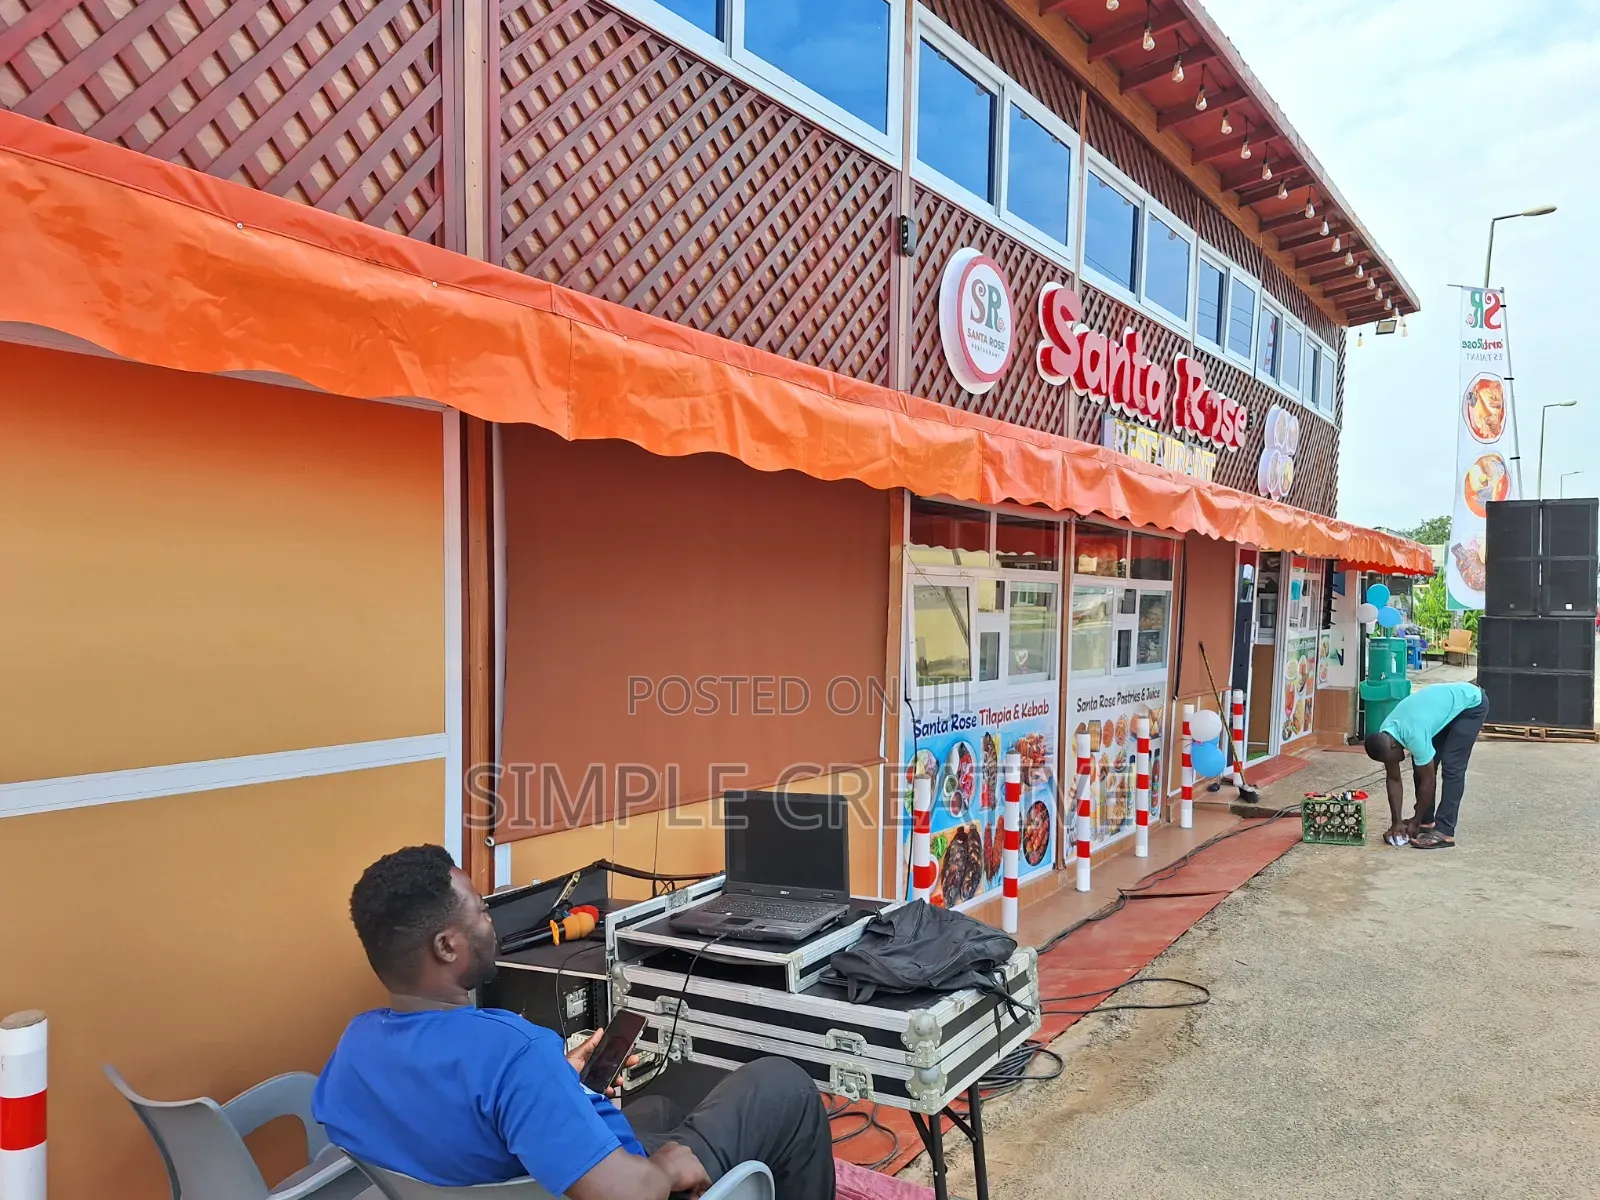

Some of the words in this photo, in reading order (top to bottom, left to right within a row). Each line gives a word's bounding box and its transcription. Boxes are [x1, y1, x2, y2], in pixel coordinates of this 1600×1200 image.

[967, 328, 988, 345] SANTA
[989, 337, 1005, 352] ROSE
[1040, 286, 1166, 422] Santa
[1177, 356, 1247, 450] Rose
[1115, 419, 1216, 482] RESTAURANT
[914, 716, 948, 738] Santa
[951, 714, 977, 731] Rose
[979, 707, 1012, 728] Tilapia
[1013, 703, 1020, 720] &
[1021, 699, 1050, 718] Kebab
[1077, 696, 1098, 713] Santa
[1099, 694, 1116, 708] Rose
[1117, 689, 1141, 706] Pastries
[1141, 687, 1146, 701] &
[1146, 687, 1160, 700] Juice
